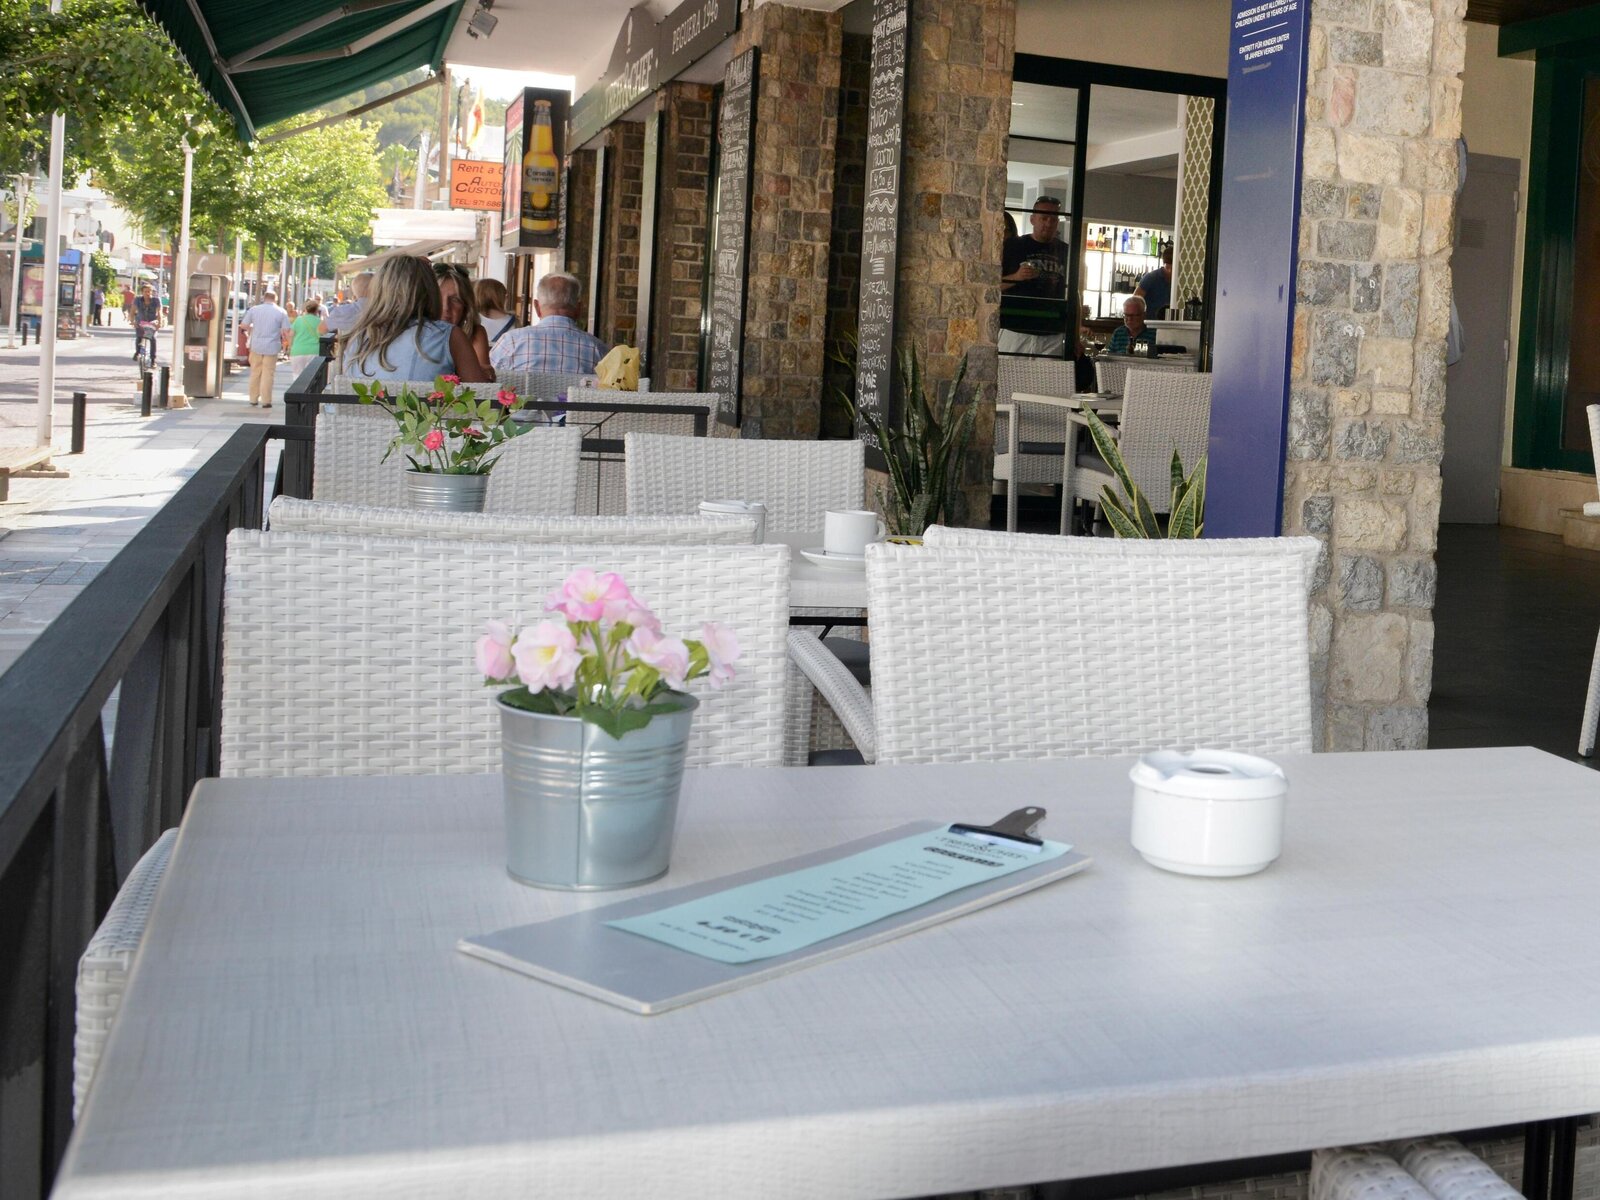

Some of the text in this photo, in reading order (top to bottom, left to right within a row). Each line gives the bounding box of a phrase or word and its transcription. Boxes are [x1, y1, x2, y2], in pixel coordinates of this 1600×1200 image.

[1252, 13, 1266, 22] UNDER
[457, 163, 483, 173] Rent
[487, 167, 494, 175] a
